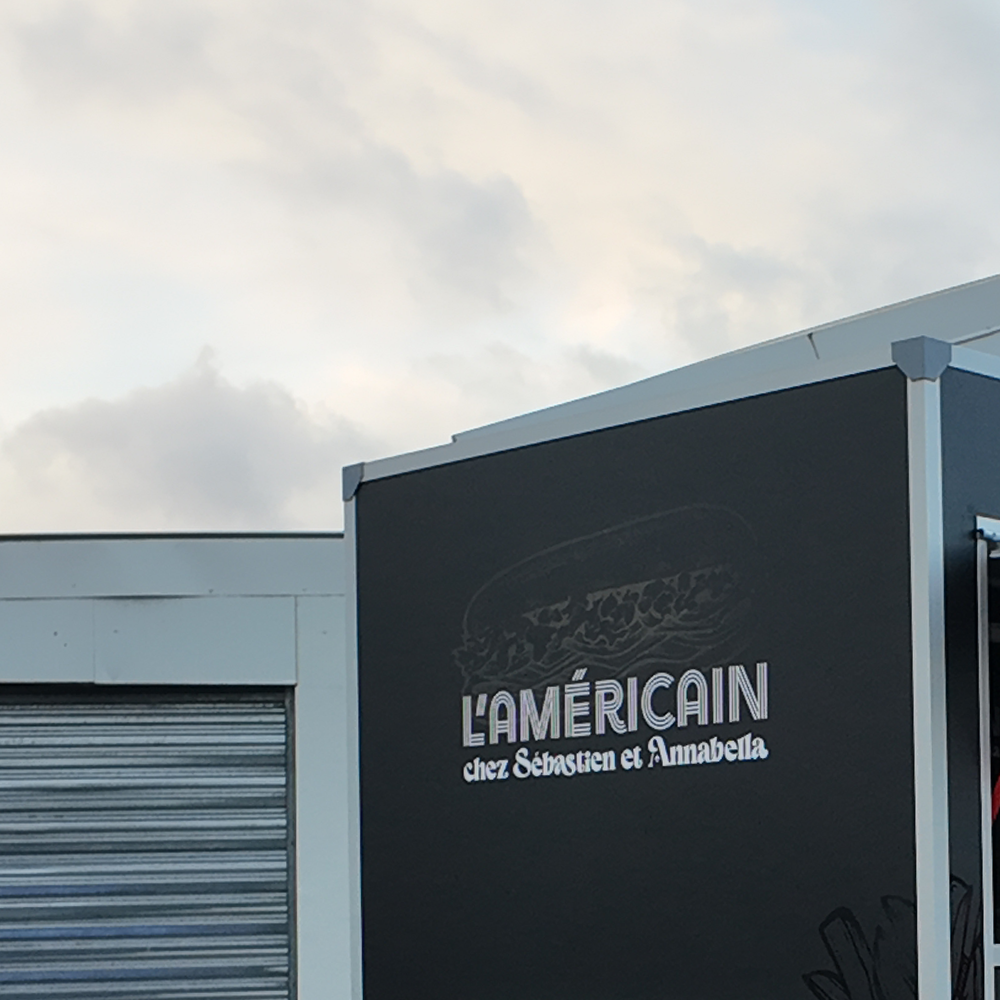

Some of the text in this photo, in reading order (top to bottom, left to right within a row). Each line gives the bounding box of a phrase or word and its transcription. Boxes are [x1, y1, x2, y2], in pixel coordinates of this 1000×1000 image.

[462, 662, 769, 747] L'AMÉRICAIN
[463, 732, 769, 783] chez Sébastien et Annabella
